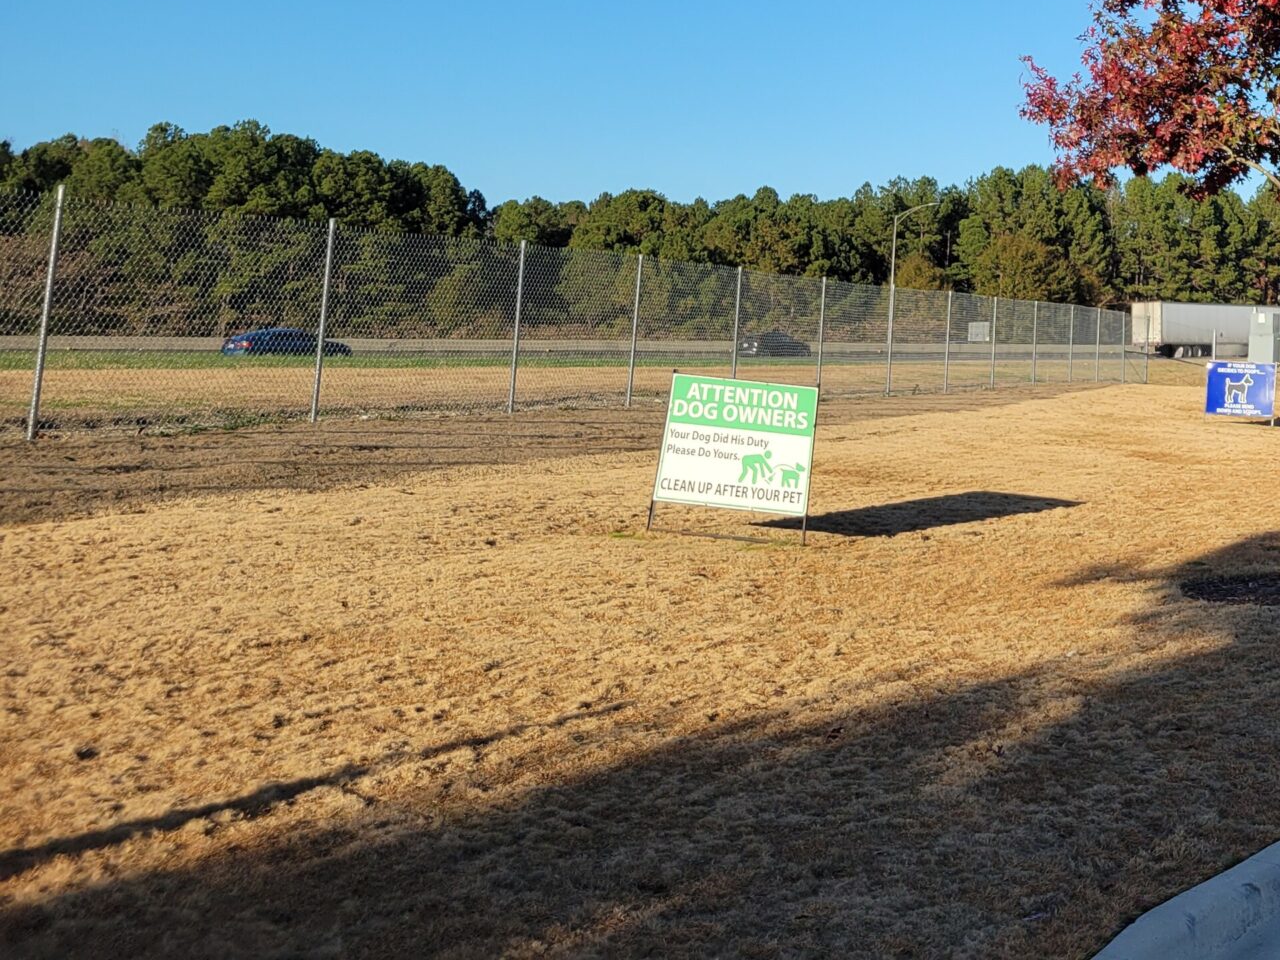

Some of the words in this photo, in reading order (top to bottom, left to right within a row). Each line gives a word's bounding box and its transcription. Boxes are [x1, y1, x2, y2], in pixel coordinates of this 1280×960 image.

[686, 382, 798, 410] ATTENTION
[672, 399, 718, 420] DOG
[722, 404, 808, 430] OWNERS
[666, 444, 696, 456] Please
[698, 447, 711, 457] Do
[713, 448, 740, 461] Yours.
[670, 428, 690, 439] Your
[692, 430, 711, 444] Dog
[713, 432, 729, 444] Did
[730, 434, 745, 446] His
[746, 436, 769, 450] Duty
[660, 477, 696, 493] CLEAN
[697, 482, 713, 495] UP
[714, 483, 748, 499] AFTER
[751, 487, 780, 502] YOUR
[782, 491, 802, 504] PET
